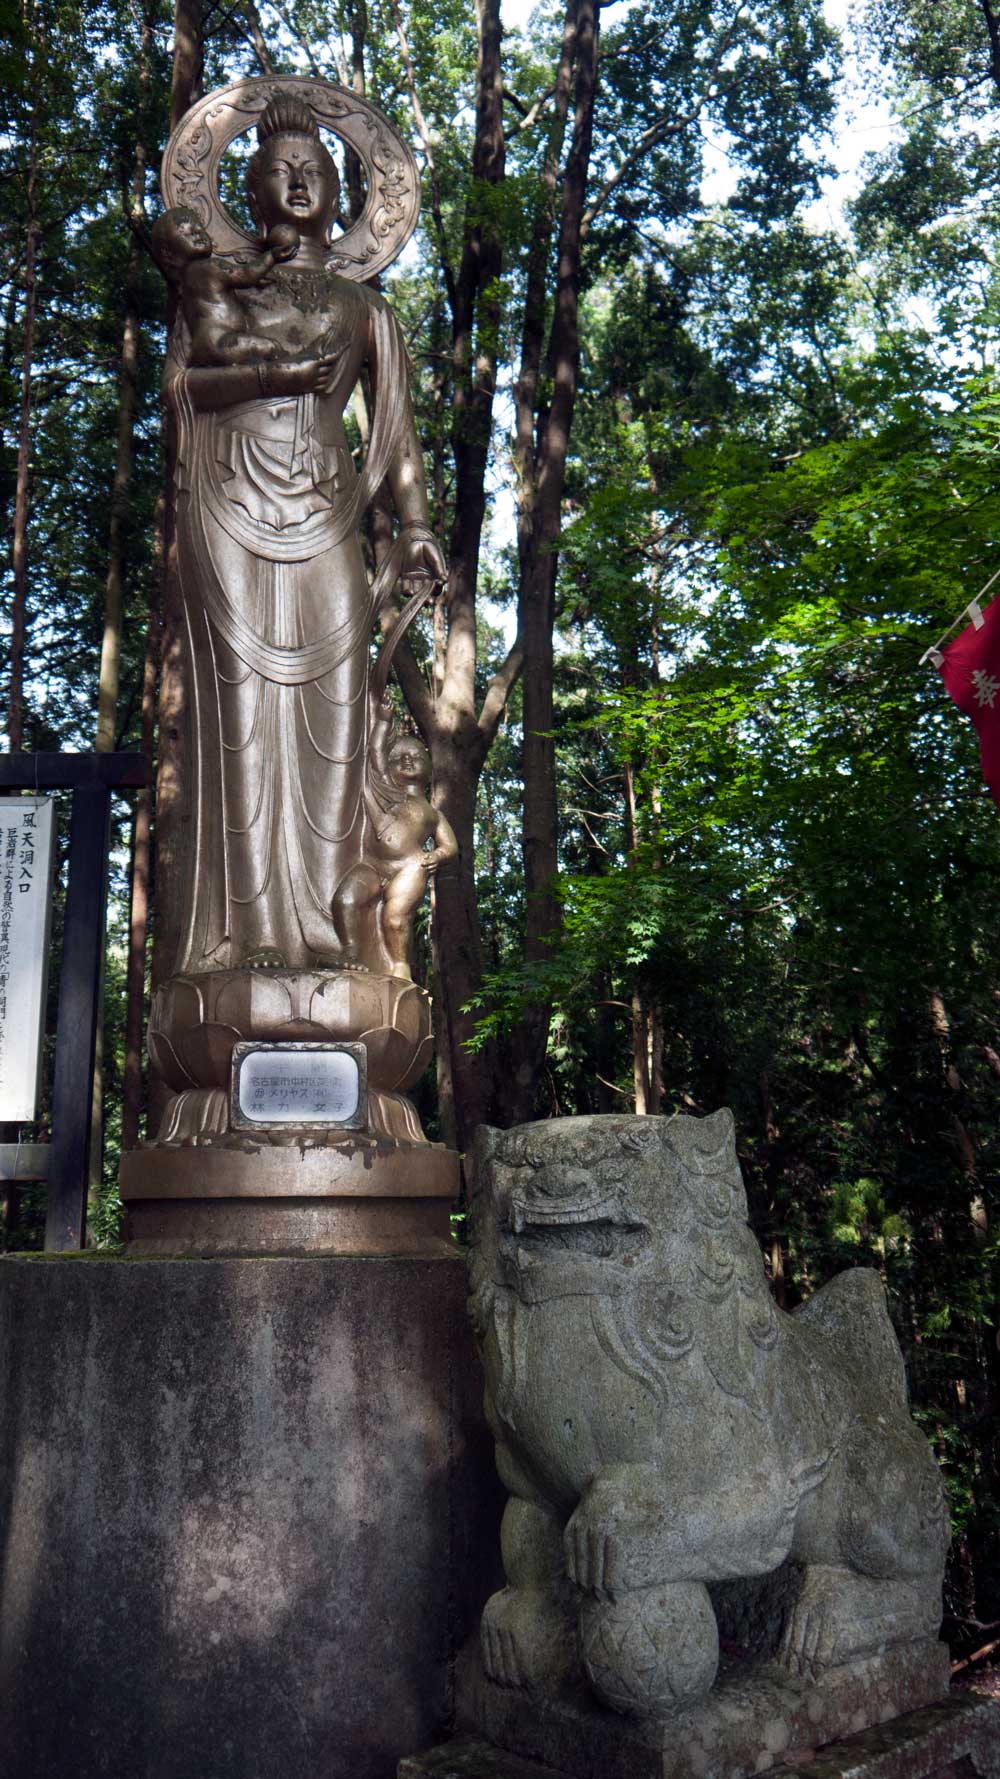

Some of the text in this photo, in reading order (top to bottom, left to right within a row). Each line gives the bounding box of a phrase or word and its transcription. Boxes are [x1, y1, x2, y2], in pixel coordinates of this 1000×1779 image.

[19, 812, 37, 893] 風天洞入口
